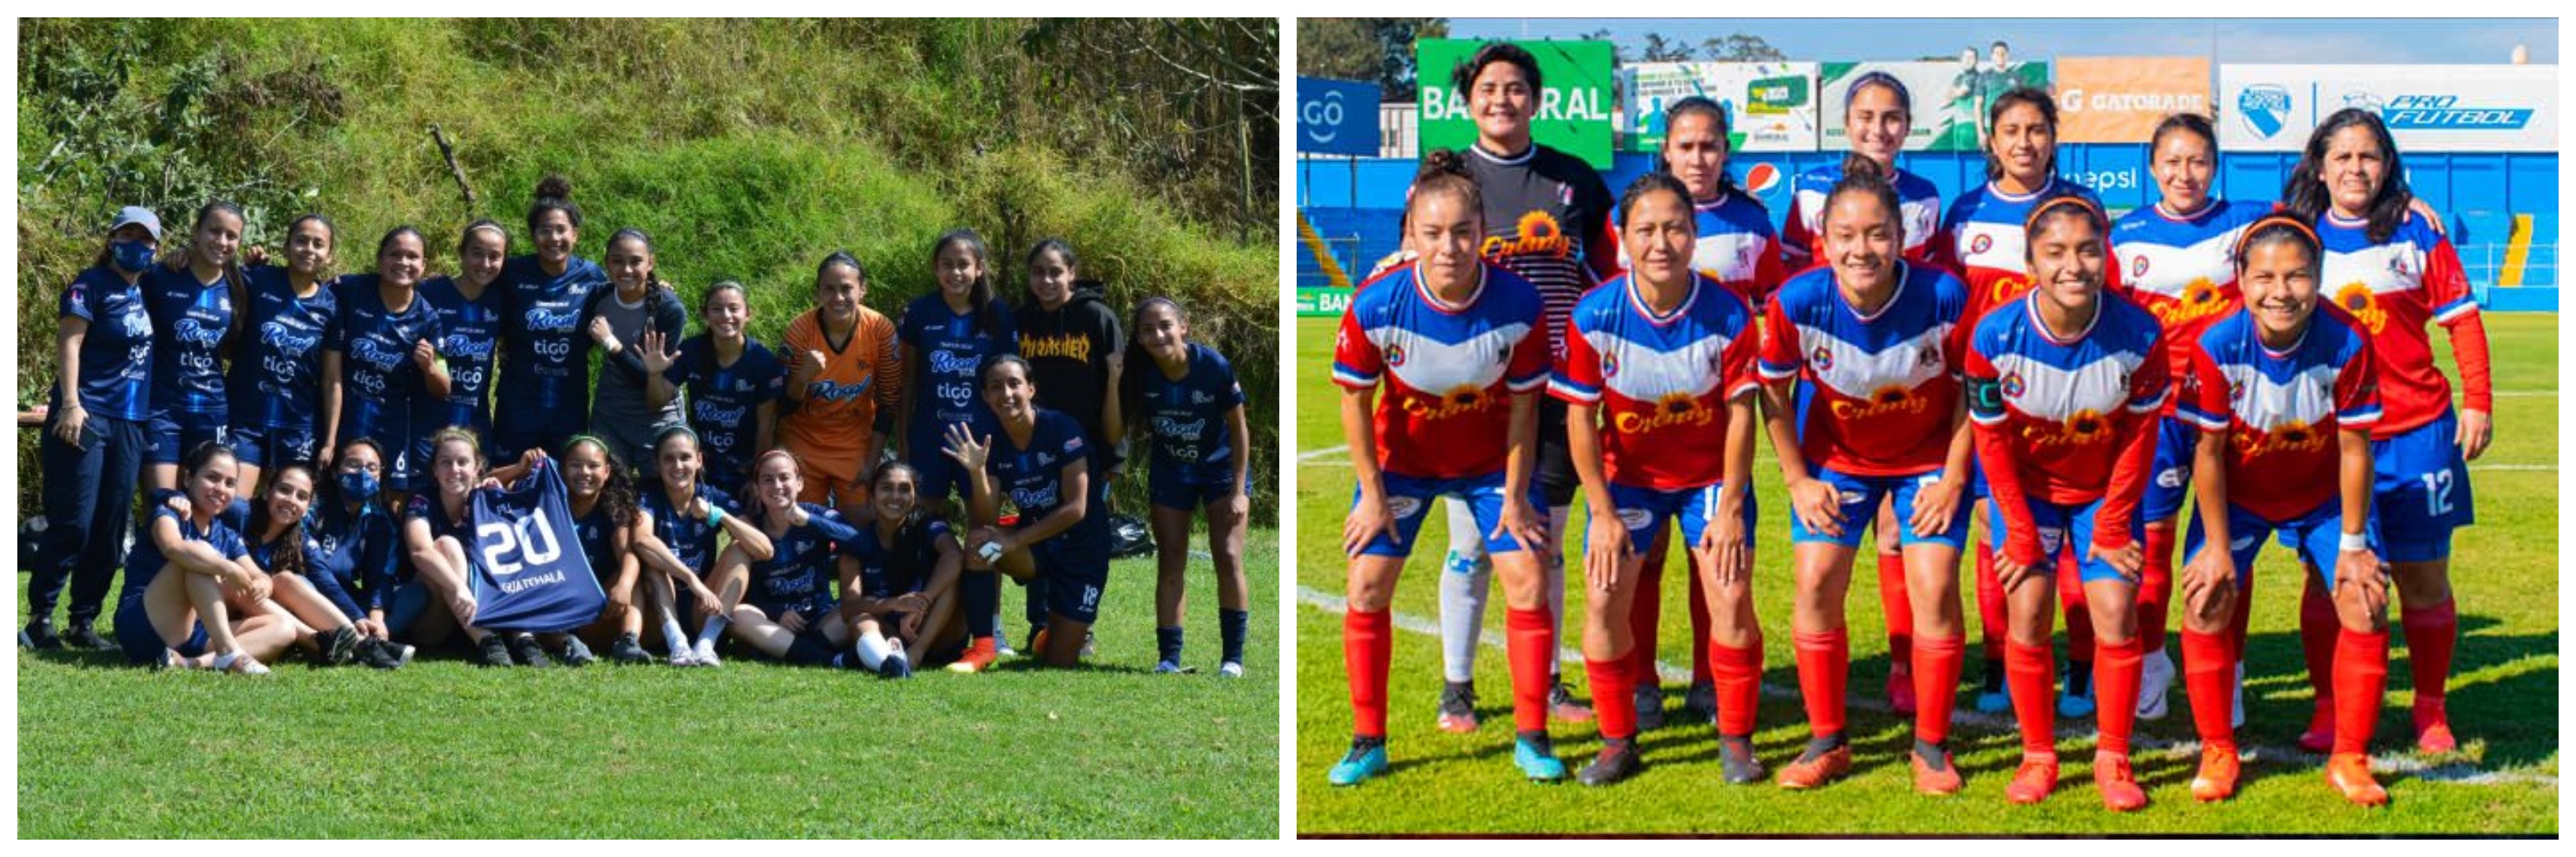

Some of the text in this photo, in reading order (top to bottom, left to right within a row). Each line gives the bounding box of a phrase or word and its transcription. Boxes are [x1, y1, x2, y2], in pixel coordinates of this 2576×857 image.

[1423, 87, 1608, 121] BARAL
[2092, 92, 2203, 110] GATORADE
[2390, 95, 2458, 107] PRO
[2390, 110, 2523, 124] FUTBOL
[1019, 332, 1091, 365] THRASHER
[396, 451, 406, 472] 6
[2421, 468, 2454, 517] 12
[477, 507, 561, 574] 20
[501, 570, 565, 595] GUATEMALA
[1083, 584, 1099, 607] 18
